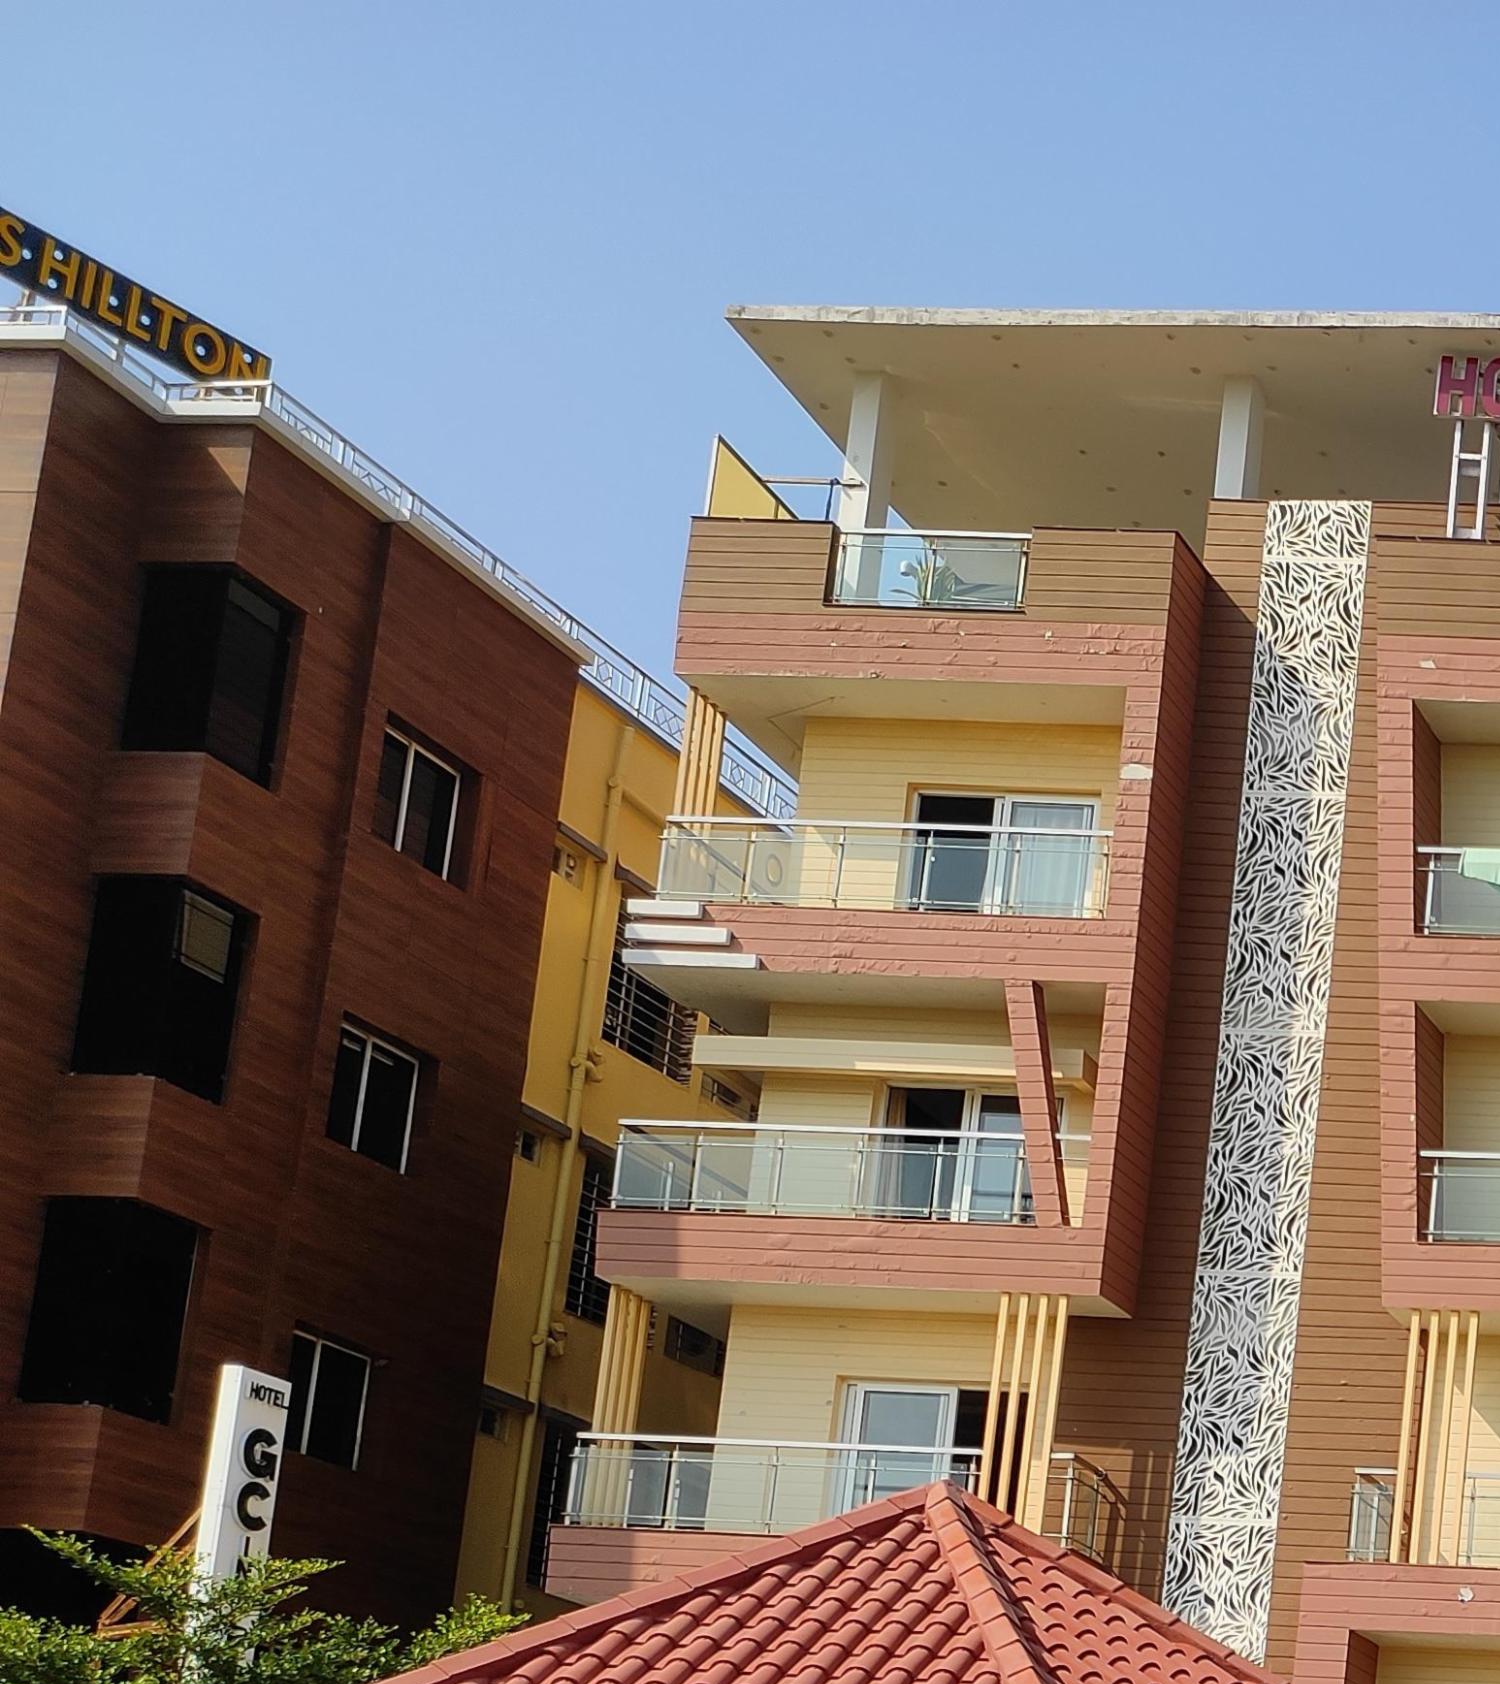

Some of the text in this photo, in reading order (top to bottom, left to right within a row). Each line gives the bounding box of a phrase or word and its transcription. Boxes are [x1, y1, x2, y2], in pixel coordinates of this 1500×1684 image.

[38, 237, 268, 380] HILLTON
[249, 1381, 290, 1410] HOTEL
[236, 1428, 278, 1532] GC
